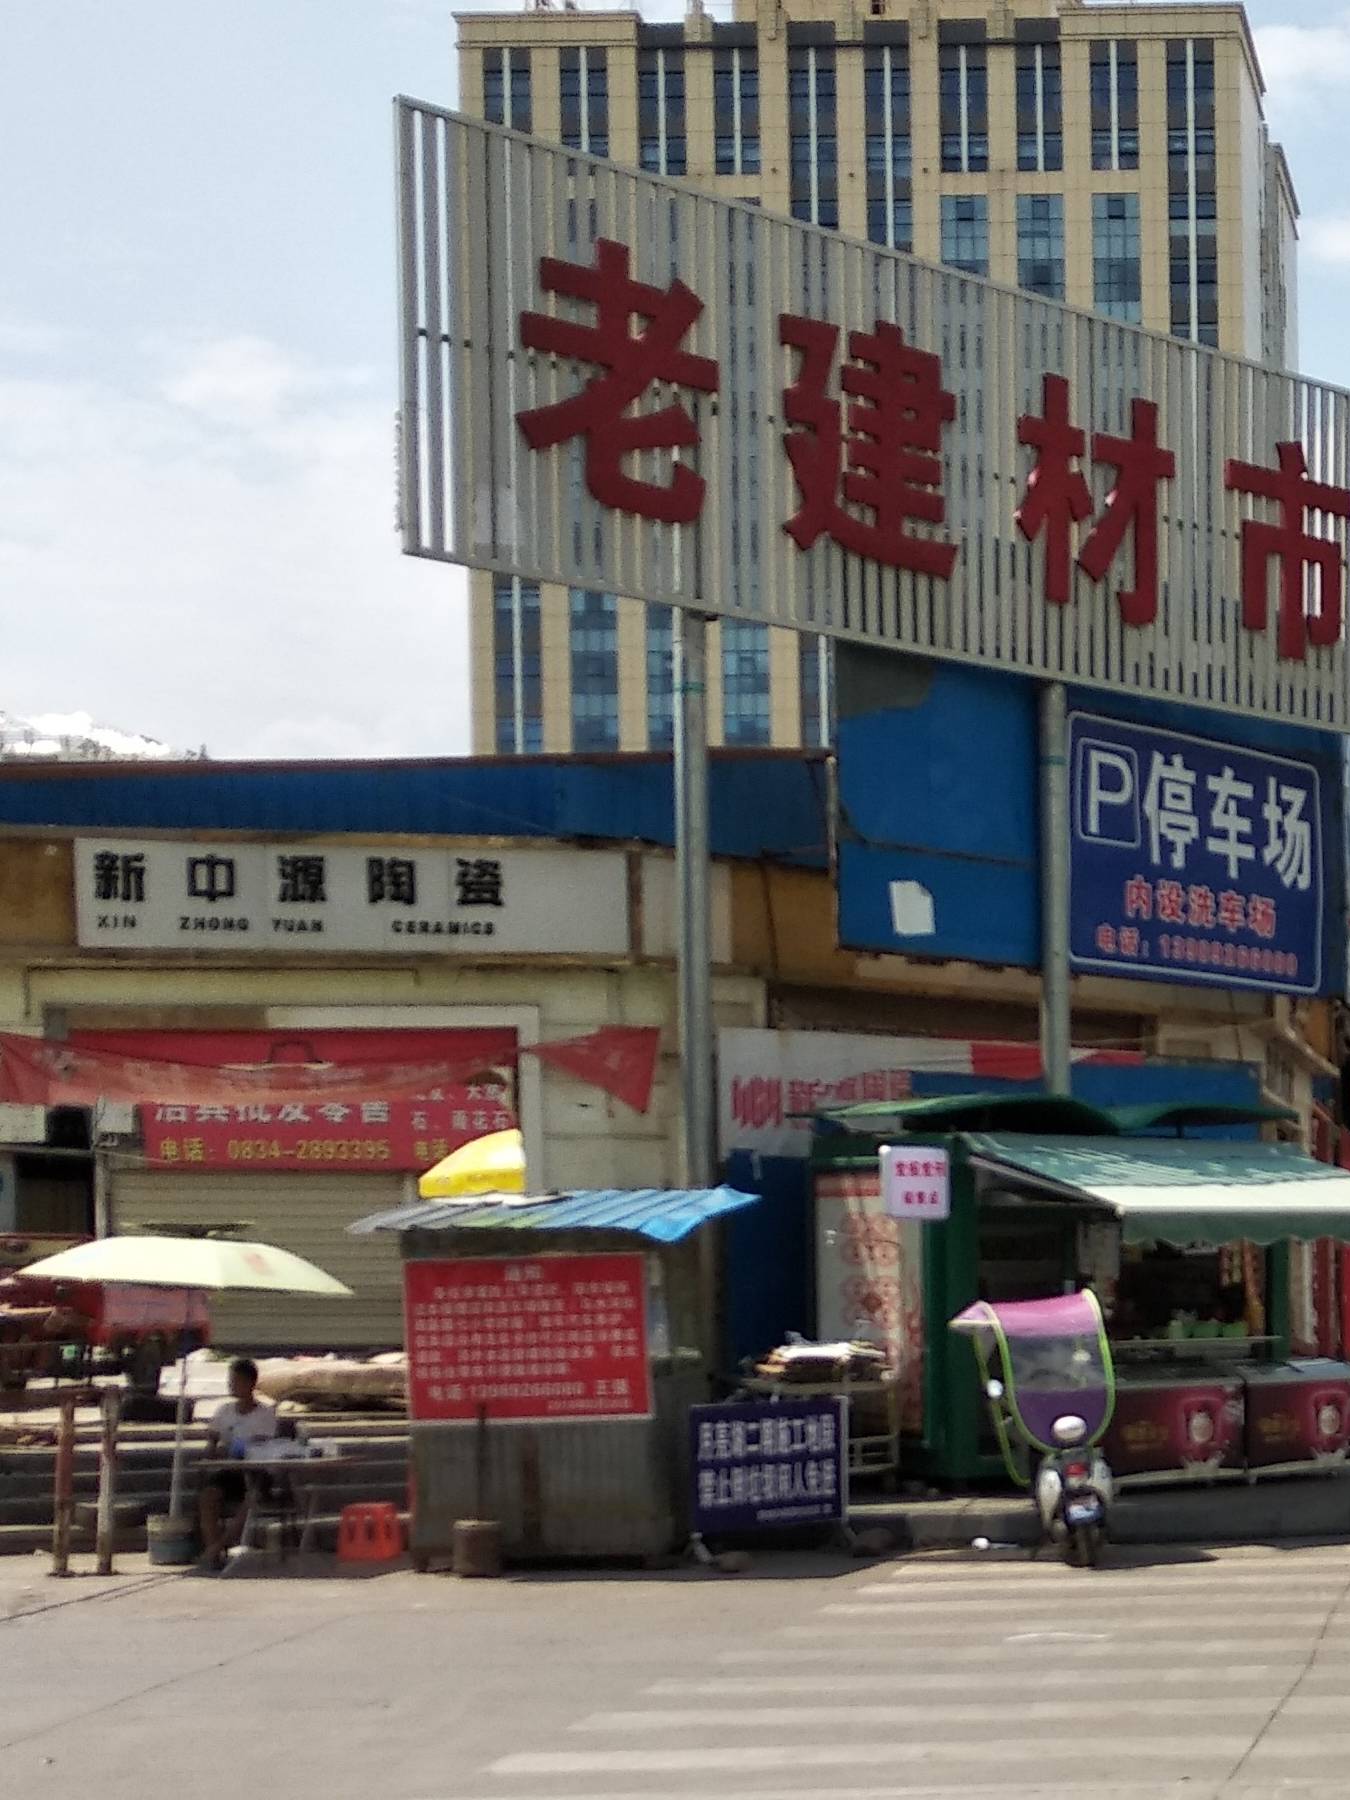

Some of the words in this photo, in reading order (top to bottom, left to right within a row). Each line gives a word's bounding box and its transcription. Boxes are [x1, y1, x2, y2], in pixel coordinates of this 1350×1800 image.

[1088, 749, 1134, 834] P
[1143, 750, 1312, 892] 停车场
[93, 850, 504, 906] 新中源陶瓷
[1124, 873, 1277, 940] 内设洗车场
[97, 915, 137, 929] XIN
[180, 916, 250, 931] ZHONG
[272, 917, 325, 933] YUAN
[391, 918, 496, 936] CERAMICS
